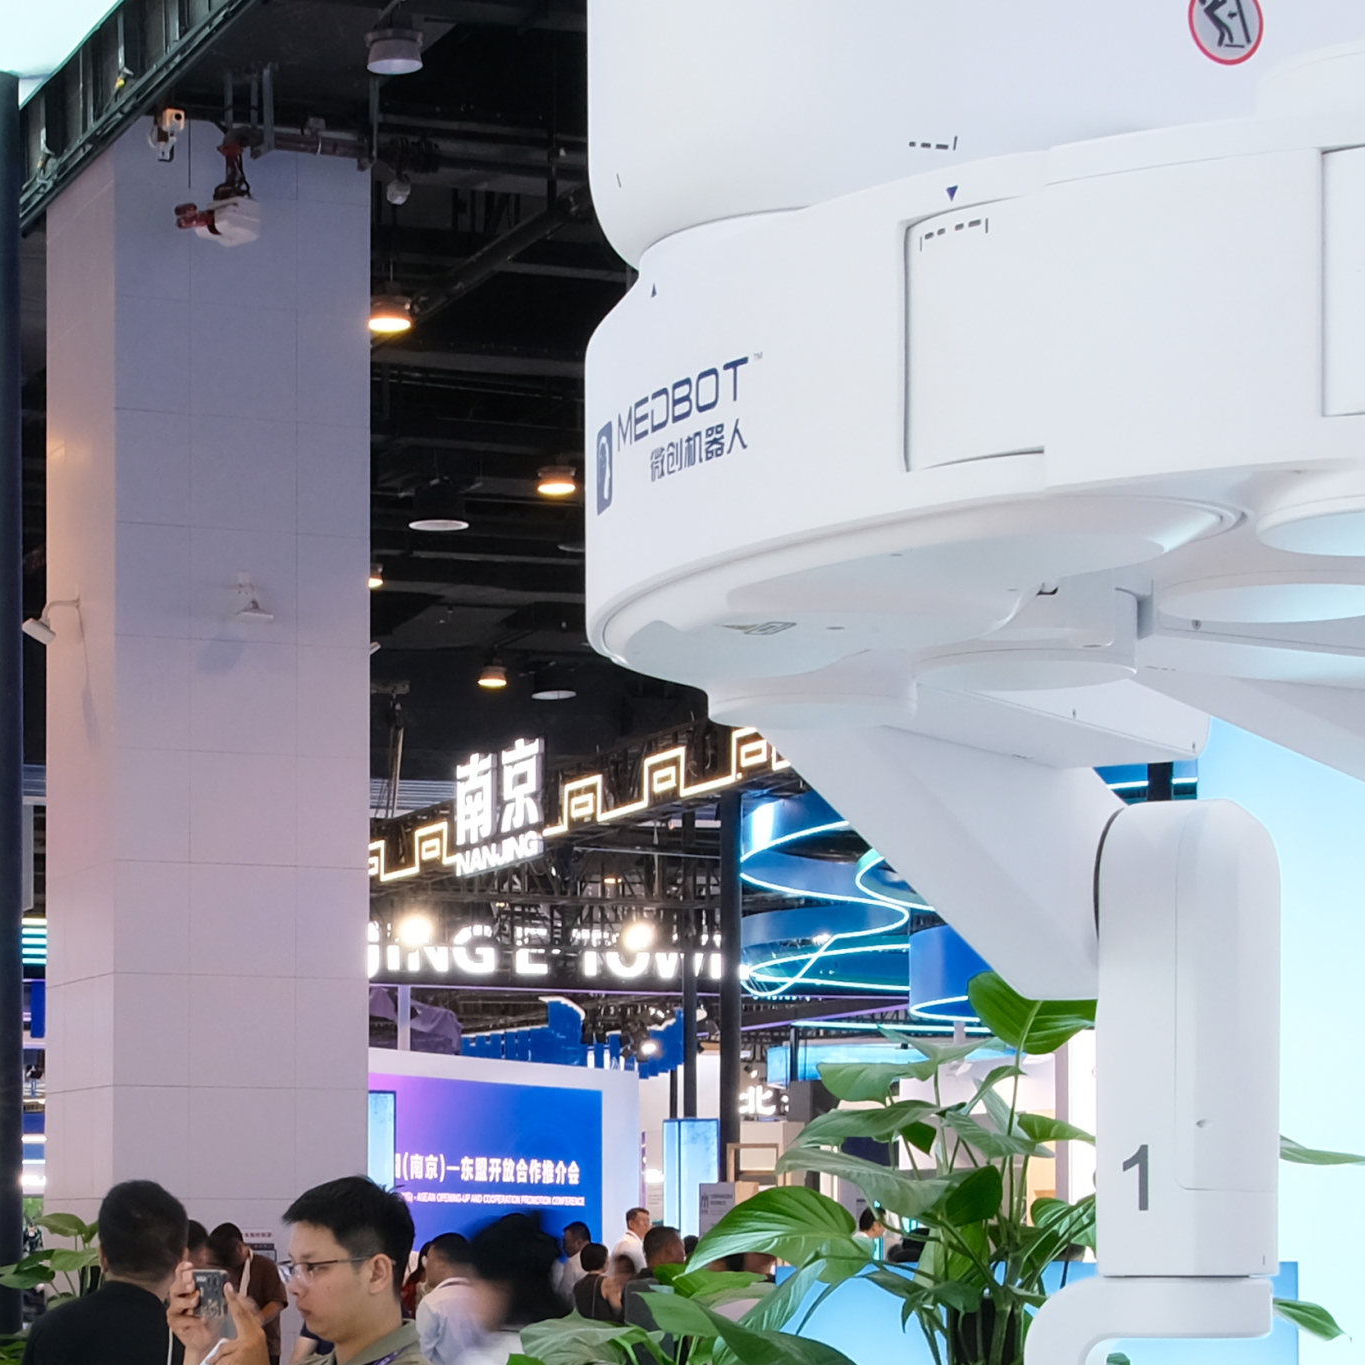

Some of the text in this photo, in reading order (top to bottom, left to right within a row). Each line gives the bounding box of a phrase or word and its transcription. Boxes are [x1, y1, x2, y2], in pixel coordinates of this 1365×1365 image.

[617, 356, 748, 452] MEDBOT
[649, 418, 748, 482] 微创机器人
[455, 738, 544, 847] 南京
[455, 830, 543, 878] NANJING
[1122, 1144, 1149, 1211] 1
